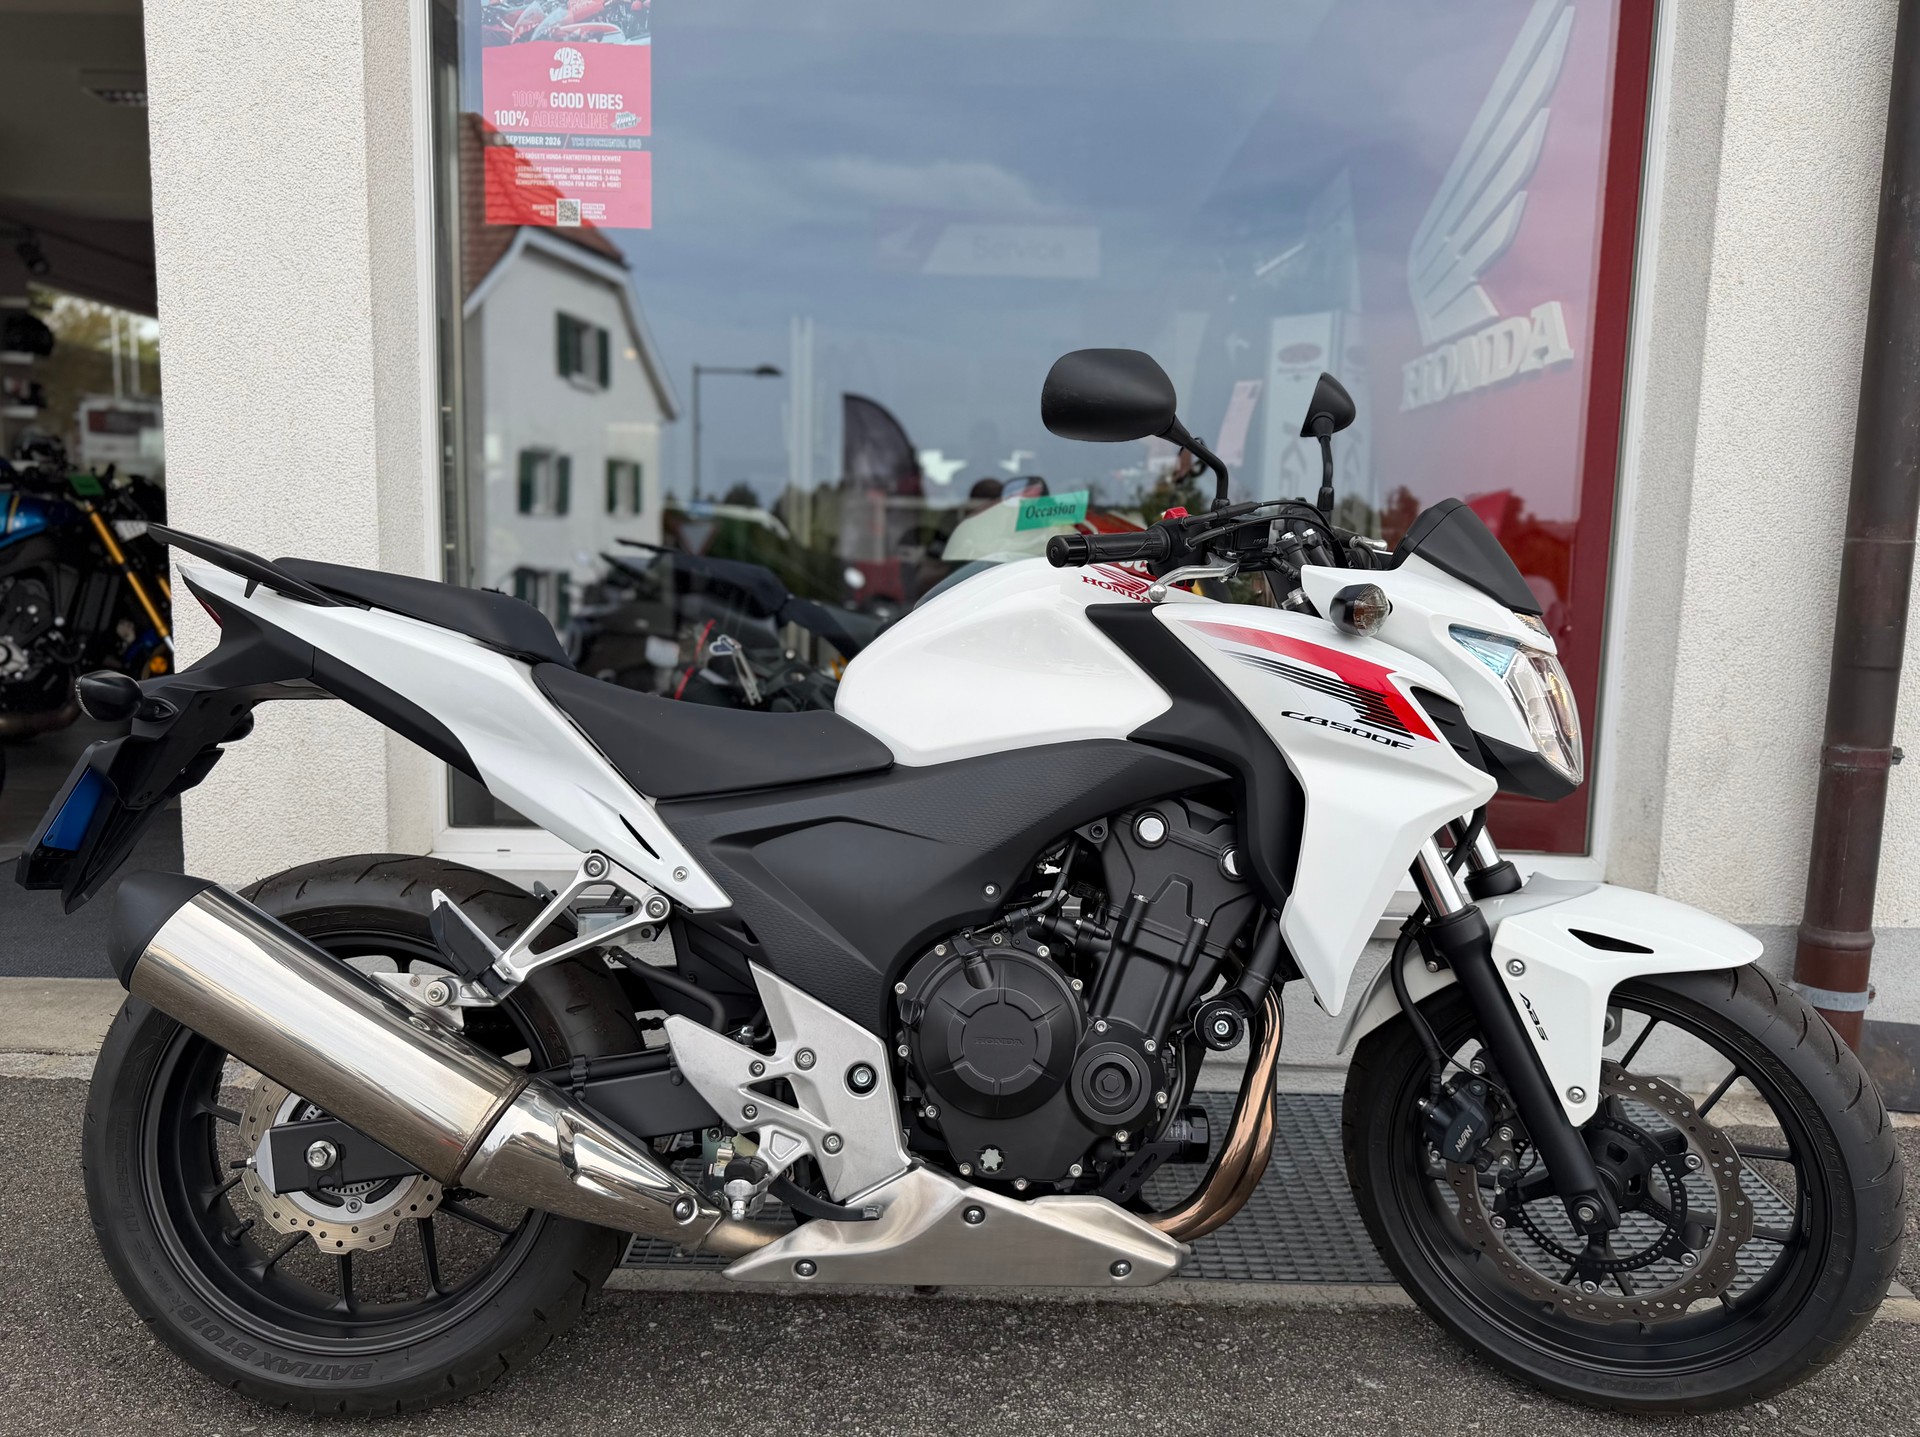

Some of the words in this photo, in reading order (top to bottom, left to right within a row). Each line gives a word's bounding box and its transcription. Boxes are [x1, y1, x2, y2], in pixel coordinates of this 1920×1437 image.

[549, 63, 585, 81] VIBES
[512, 90, 547, 108] 100%
[550, 92, 584, 109] GOOD
[587, 93, 623, 110] VIBES
[495, 110, 529, 127] 100%
[531, 111, 608, 129] ADRENALINE
[505, 135, 544, 146] SEPTEMBER
[545, 136, 561, 146] 2026
[1401, 301, 1574, 412] HONDA
[1025, 503, 1076, 519] Occasion
[1281, 711, 1414, 749] CB500F
[1519, 992, 1549, 1041] ABS
[975, 1036, 1025, 1046] HONDA
[1455, 1124, 1473, 1152] NISSIN
[256, 1351, 374, 1380] BATTLAX
